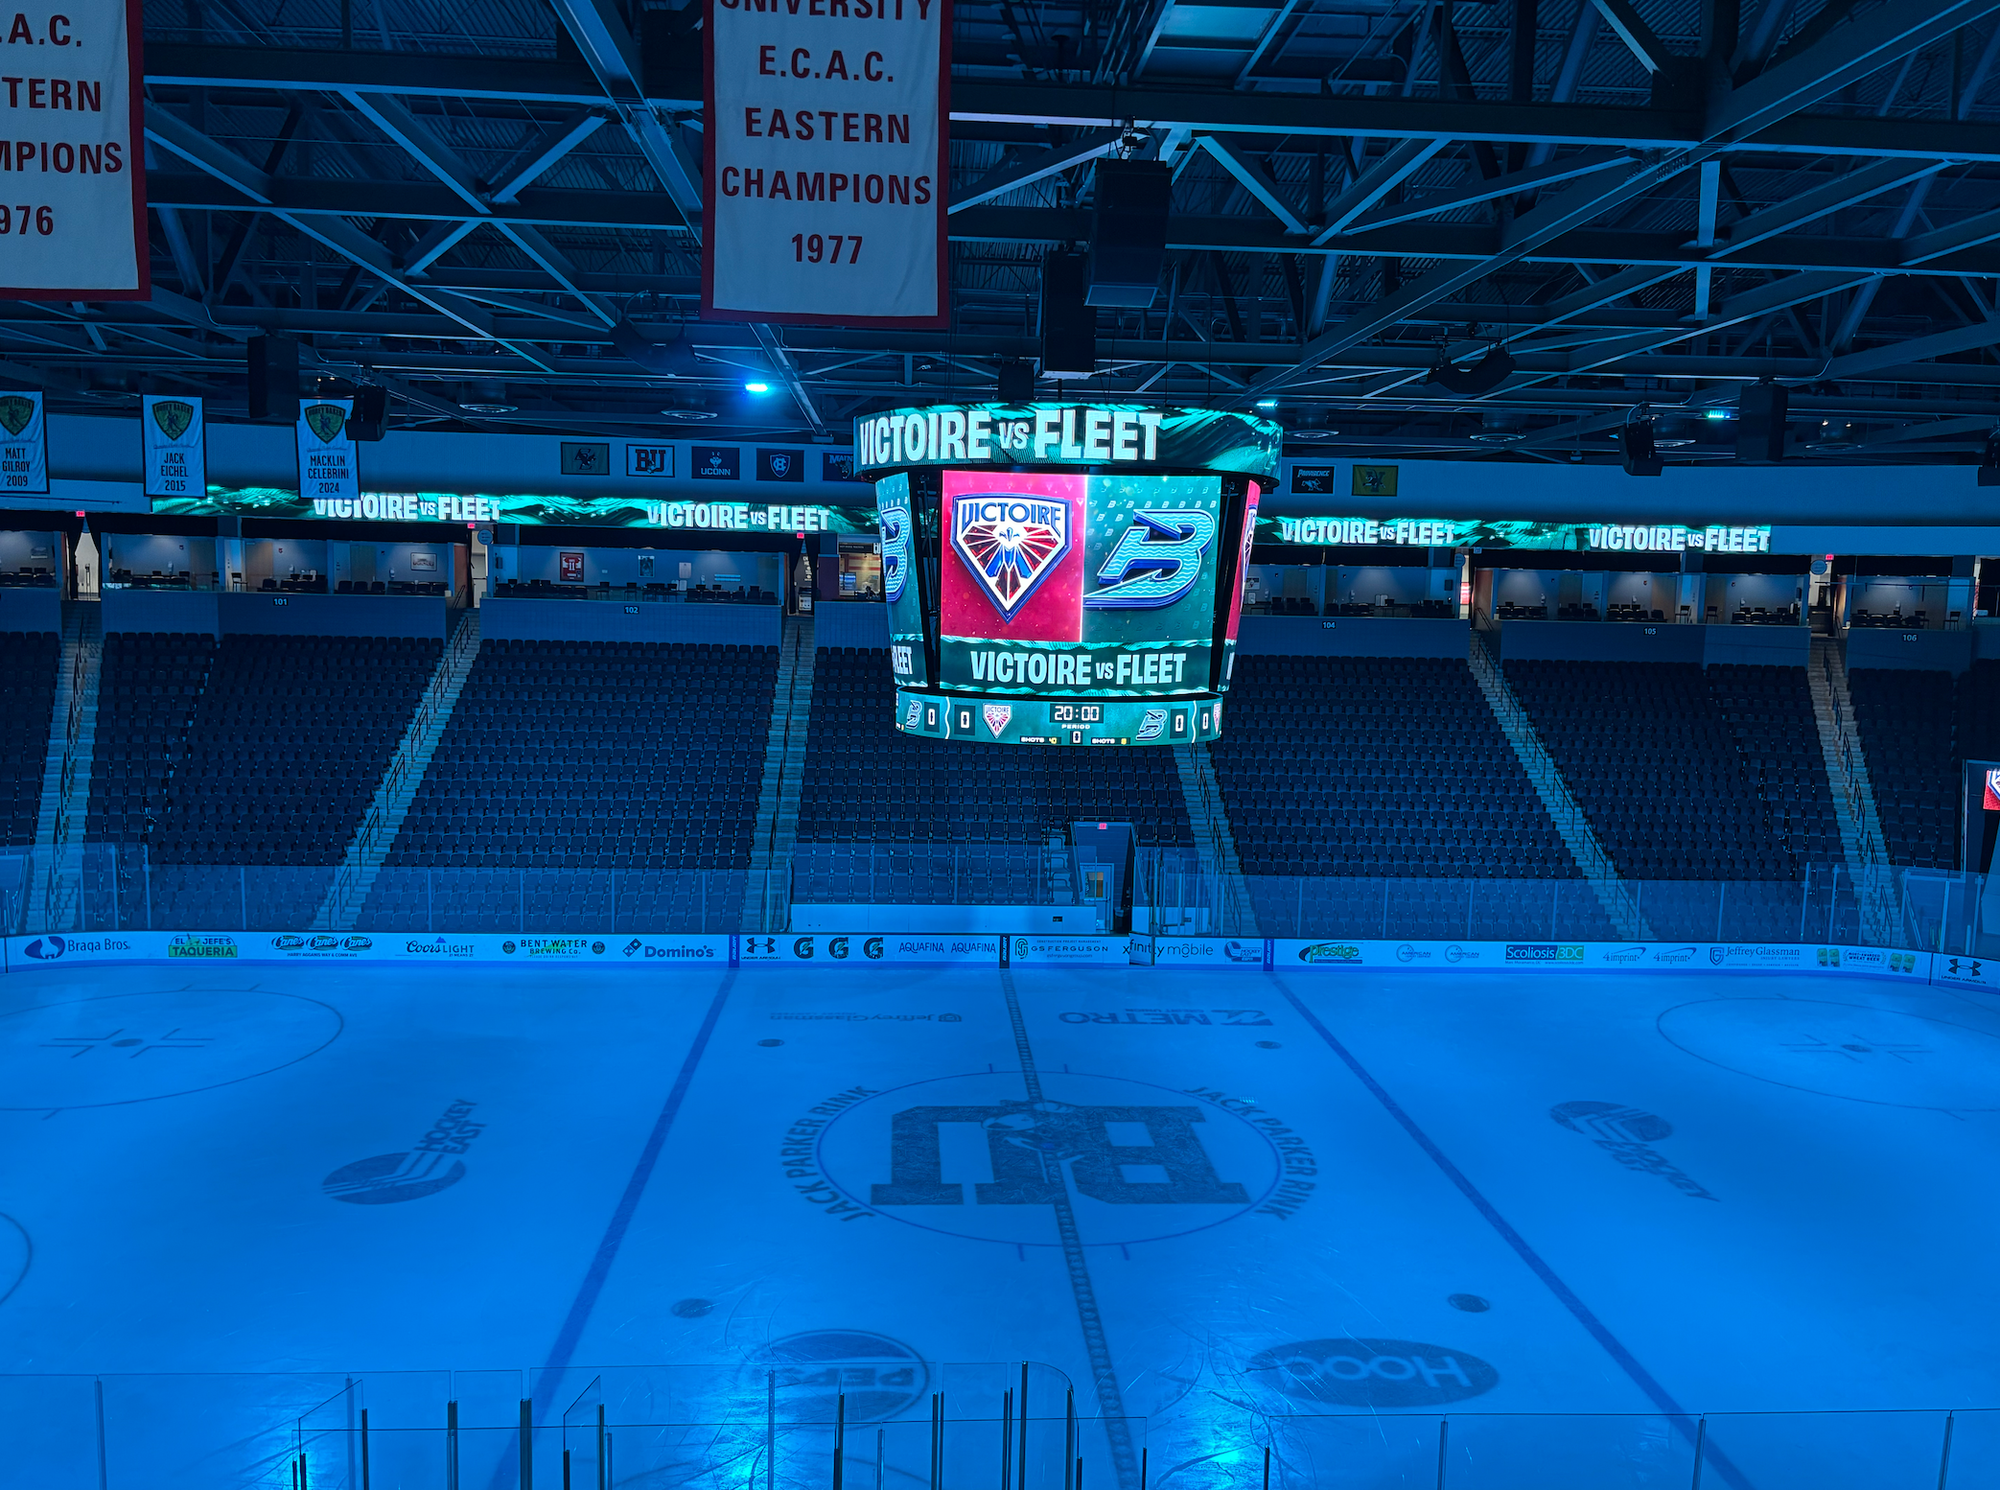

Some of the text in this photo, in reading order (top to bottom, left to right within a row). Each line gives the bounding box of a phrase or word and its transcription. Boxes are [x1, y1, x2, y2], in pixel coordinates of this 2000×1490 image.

[759, 45, 893, 82] E.C.A.C.
[745, 107, 910, 144] EASTERN
[721, 166, 931, 205] CHAMPIONS
[791, 233, 863, 264] 1977
[859, 411, 992, 465] VICTOIRE
[1034, 409, 1163, 460] FLEET
[6, 448, 26, 459] MATT
[164, 453, 185, 464] JACK
[310, 455, 346, 466] MACKLIN
[635, 449, 666, 472] BU
[2, 461, 30, 472] GILROY
[161, 466, 188, 477] EICHEL
[307, 468, 349, 479] CELEBRINI
[701, 467, 731, 477] UCONN
[6, 476, 28, 487] 2009
[165, 480, 186, 491] 2015
[318, 482, 340, 493] 2024
[313, 493, 419, 520] VICTOIRE
[438, 495, 500, 521] FLEET
[647, 503, 749, 529] VICTOIRE
[767, 506, 829, 531] FLEET
[961, 502, 1062, 538] VICTOIRE
[1281, 519, 1379, 545] VICTOIRE
[1396, 521, 1456, 545] FLEET
[1589, 526, 1687, 551] VICTOIRE
[1704, 527, 1771, 552] FLEET
[273, 598, 287, 606] 101
[625, 606, 639, 614] 102
[1322, 621, 1336, 629] 104
[1903, 634, 1917, 642] 106
[970, 651, 1092, 685] VICTOIRE
[1116, 653, 1187, 685] FLEET
[928, 709, 936, 725] 0
[960, 711, 970, 729] 0
[1054, 705, 1100, 721] 20:00
[1174, 715, 1184, 731] 0
[1202, 713, 1209, 730] 0
[1072, 731, 1081, 743] 0
[68, 938, 130, 953] Braga Bros.
[172, 946, 235, 957] TAQUERIA
[406, 940, 475, 954] Coors LIGHT
[521, 939, 587, 948] BENT WATER
[645, 944, 714, 958] Domino's
[794, 937, 814, 959] G
[828, 937, 848, 959] G
[863, 937, 883, 959] G
[899, 941, 945, 954] AQUAFINA
[951, 941, 997, 954] AQUAFINA
[1122, 939, 1165, 957] xfinity
[1309, 944, 1360, 963] prestige
[1507, 946, 1555, 959] Scoliosis
[1602, 951, 1639, 965] 4imprint
[1653, 951, 1690, 965] 4imprint
[1058, 1011, 1212, 1026] METRO
[807, 1085, 880, 1116] RINK
[413, 1098, 488, 1155] HOCKEY EAST
[780, 1118, 827, 1178] PARKER
[870, 1105, 1252, 1206] BU
[1182, 1086, 1318, 1221] JACK PARKER RINK
[793, 1180, 877, 1222] JACK
